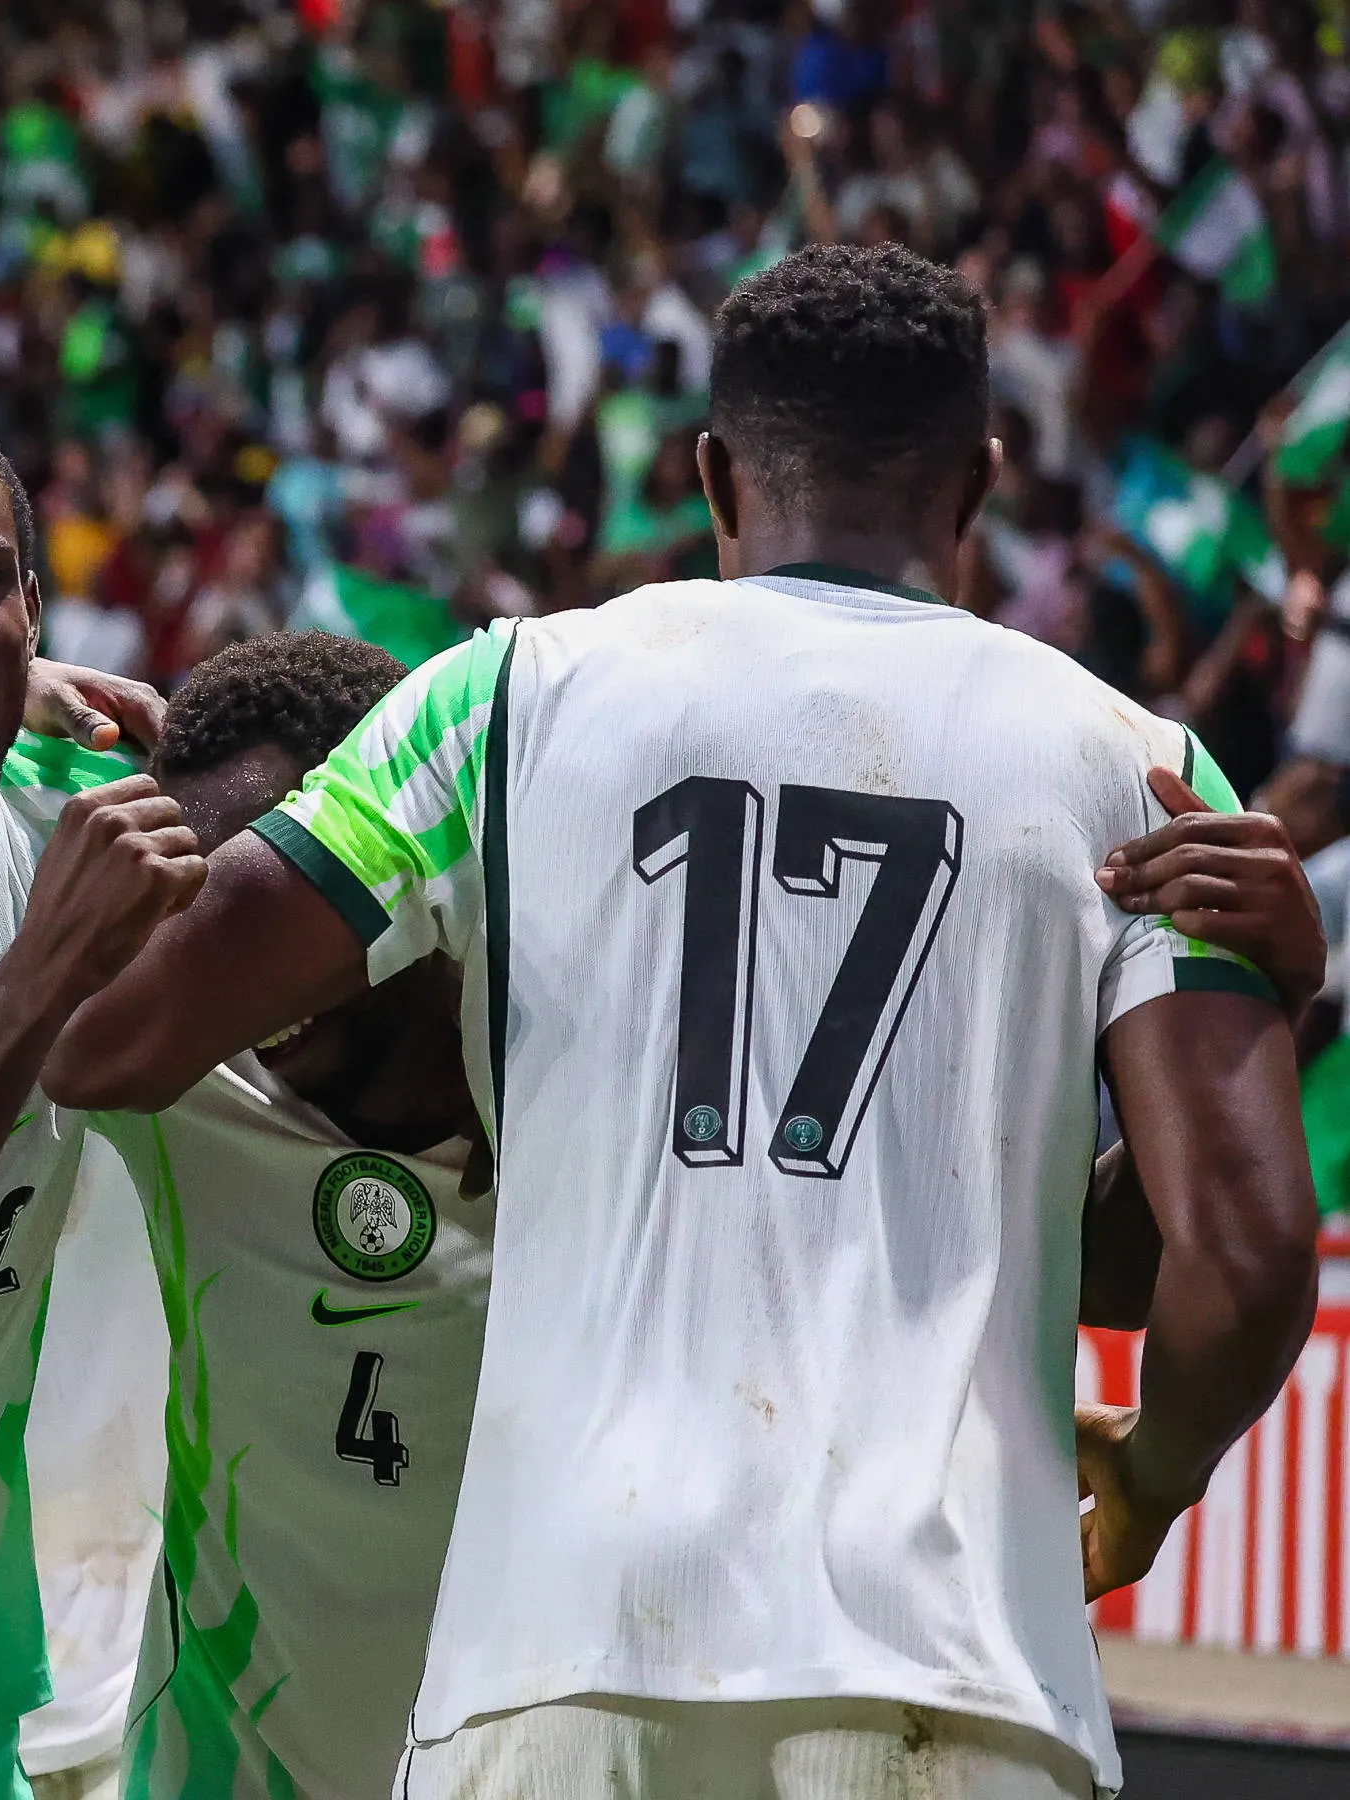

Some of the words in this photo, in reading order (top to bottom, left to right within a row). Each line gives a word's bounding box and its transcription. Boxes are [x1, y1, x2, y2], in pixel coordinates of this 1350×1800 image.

[633, 775, 964, 1181] 17
[319, 1189, 340, 1250] NIGERIA
[327, 1160, 395, 1189] FOOTBALL
[397, 1172, 428, 1263] FEDERATION
[335, 1350, 410, 1487] 4
